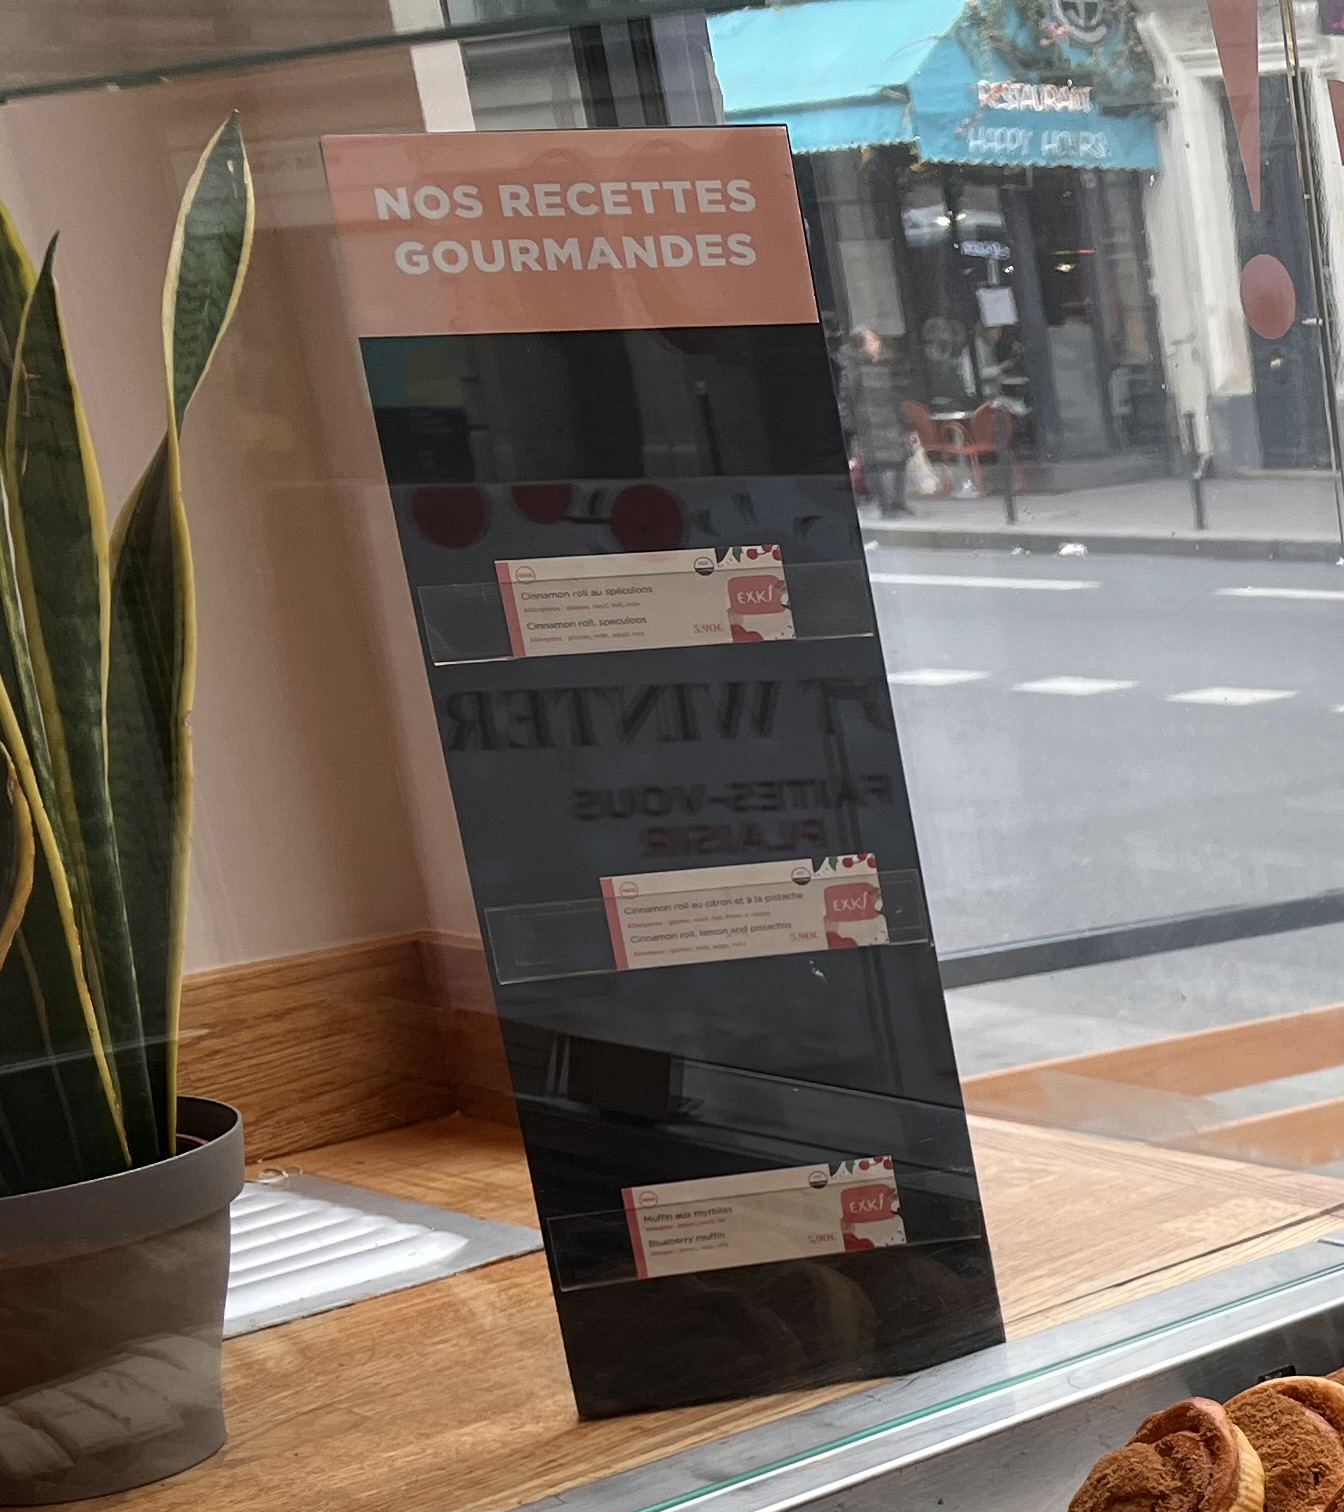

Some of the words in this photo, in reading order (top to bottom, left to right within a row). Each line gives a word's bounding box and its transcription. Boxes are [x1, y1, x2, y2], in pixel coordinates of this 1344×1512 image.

[968, 126, 1033, 156] HAPPY
[373, 185, 484, 221] NOS
[498, 179, 757, 218] RECETTES
[394, 232, 758, 276] GOURMANDES
